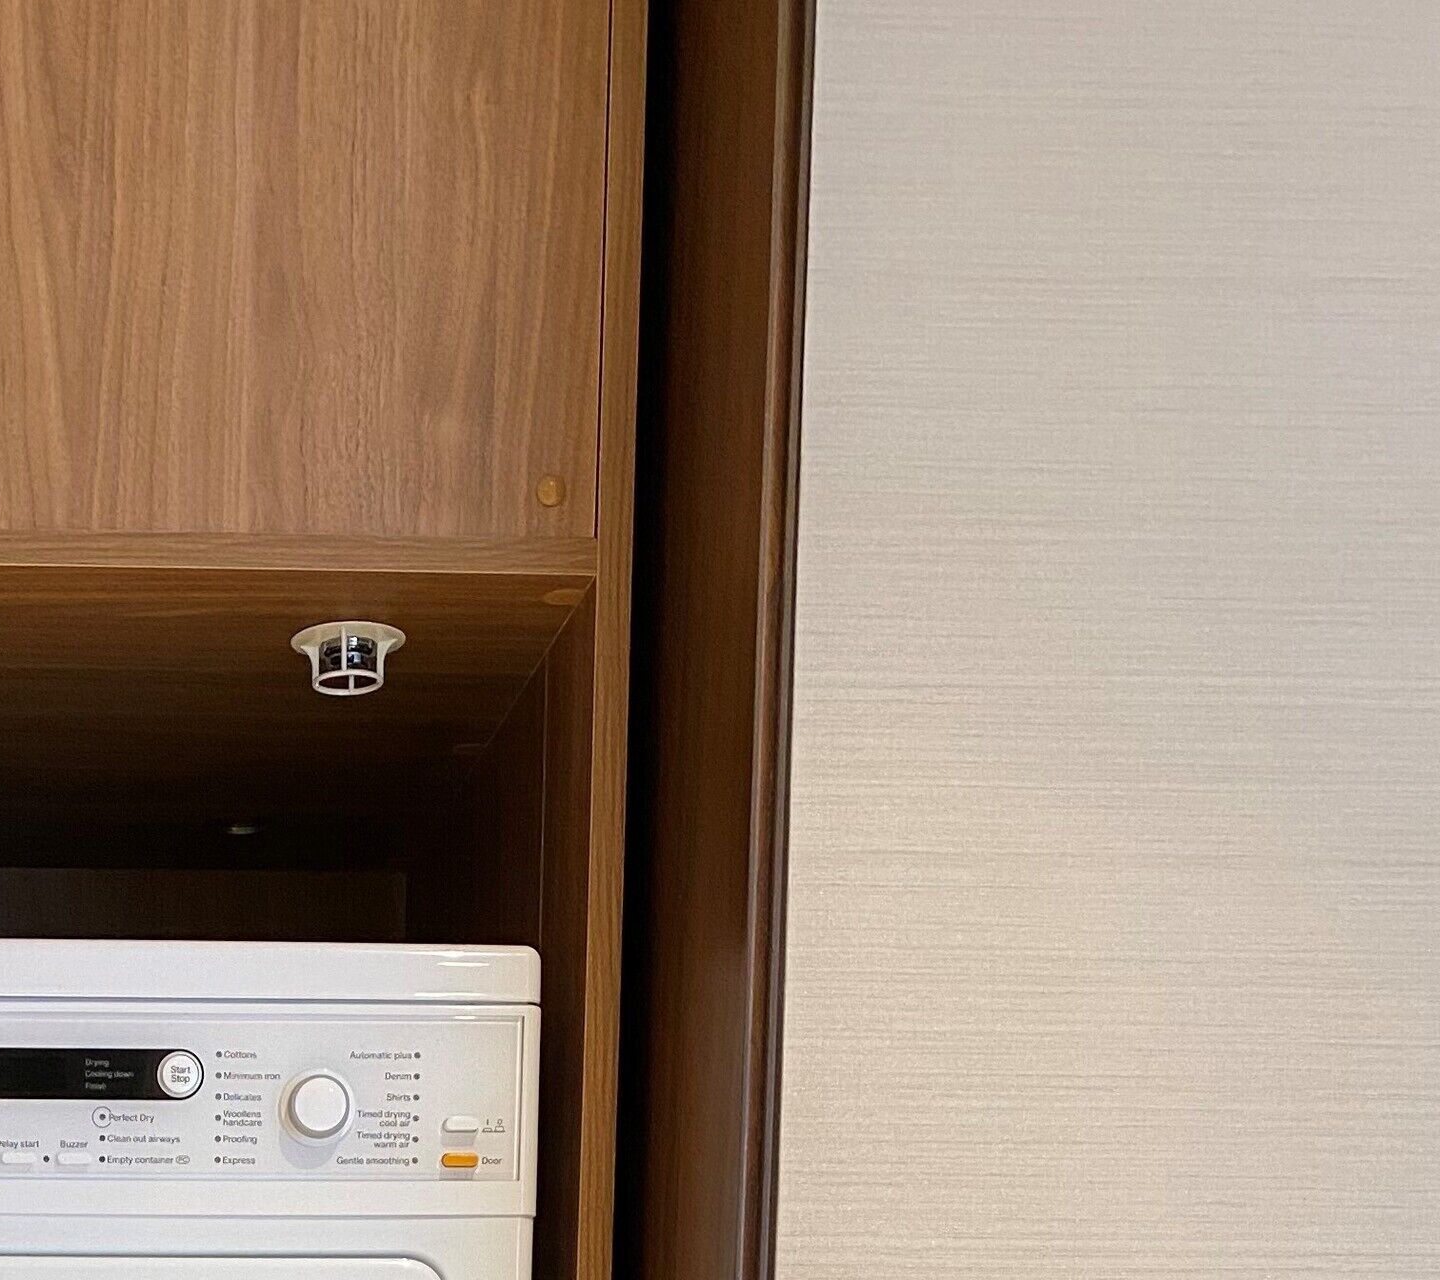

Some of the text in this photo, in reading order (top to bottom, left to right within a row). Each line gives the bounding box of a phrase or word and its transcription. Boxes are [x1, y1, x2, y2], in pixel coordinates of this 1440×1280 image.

[223, 1051, 258, 1059] Cottons
[349, 1051, 412, 1061] Automatic plus
[170, 1066, 191, 1075] Start
[171, 1074, 191, 1084] Stop
[384, 1072, 412, 1081] Denim
[386, 1093, 411, 1102] Shirts
[109, 1113, 155, 1124] Perfect Dry
[384, 1110, 411, 1120] drying
[222, 1118, 263, 1127] handcare
[399, 1119, 411, 1128] air
[107, 1135, 181, 1144] Clean out airways
[383, 1131, 410, 1141] drying
[20, 1140, 40, 1149] start
[59, 1140, 89, 1149] Buzzer
[373, 1141, 410, 1149] warm air
[107, 1156, 133, 1166] Empty
[134, 1156, 174, 1164] container
[222, 1156, 256, 1165] Express
[336, 1156, 410, 1166] Gentle smoothing
[481, 1157, 503, 1166] Door
